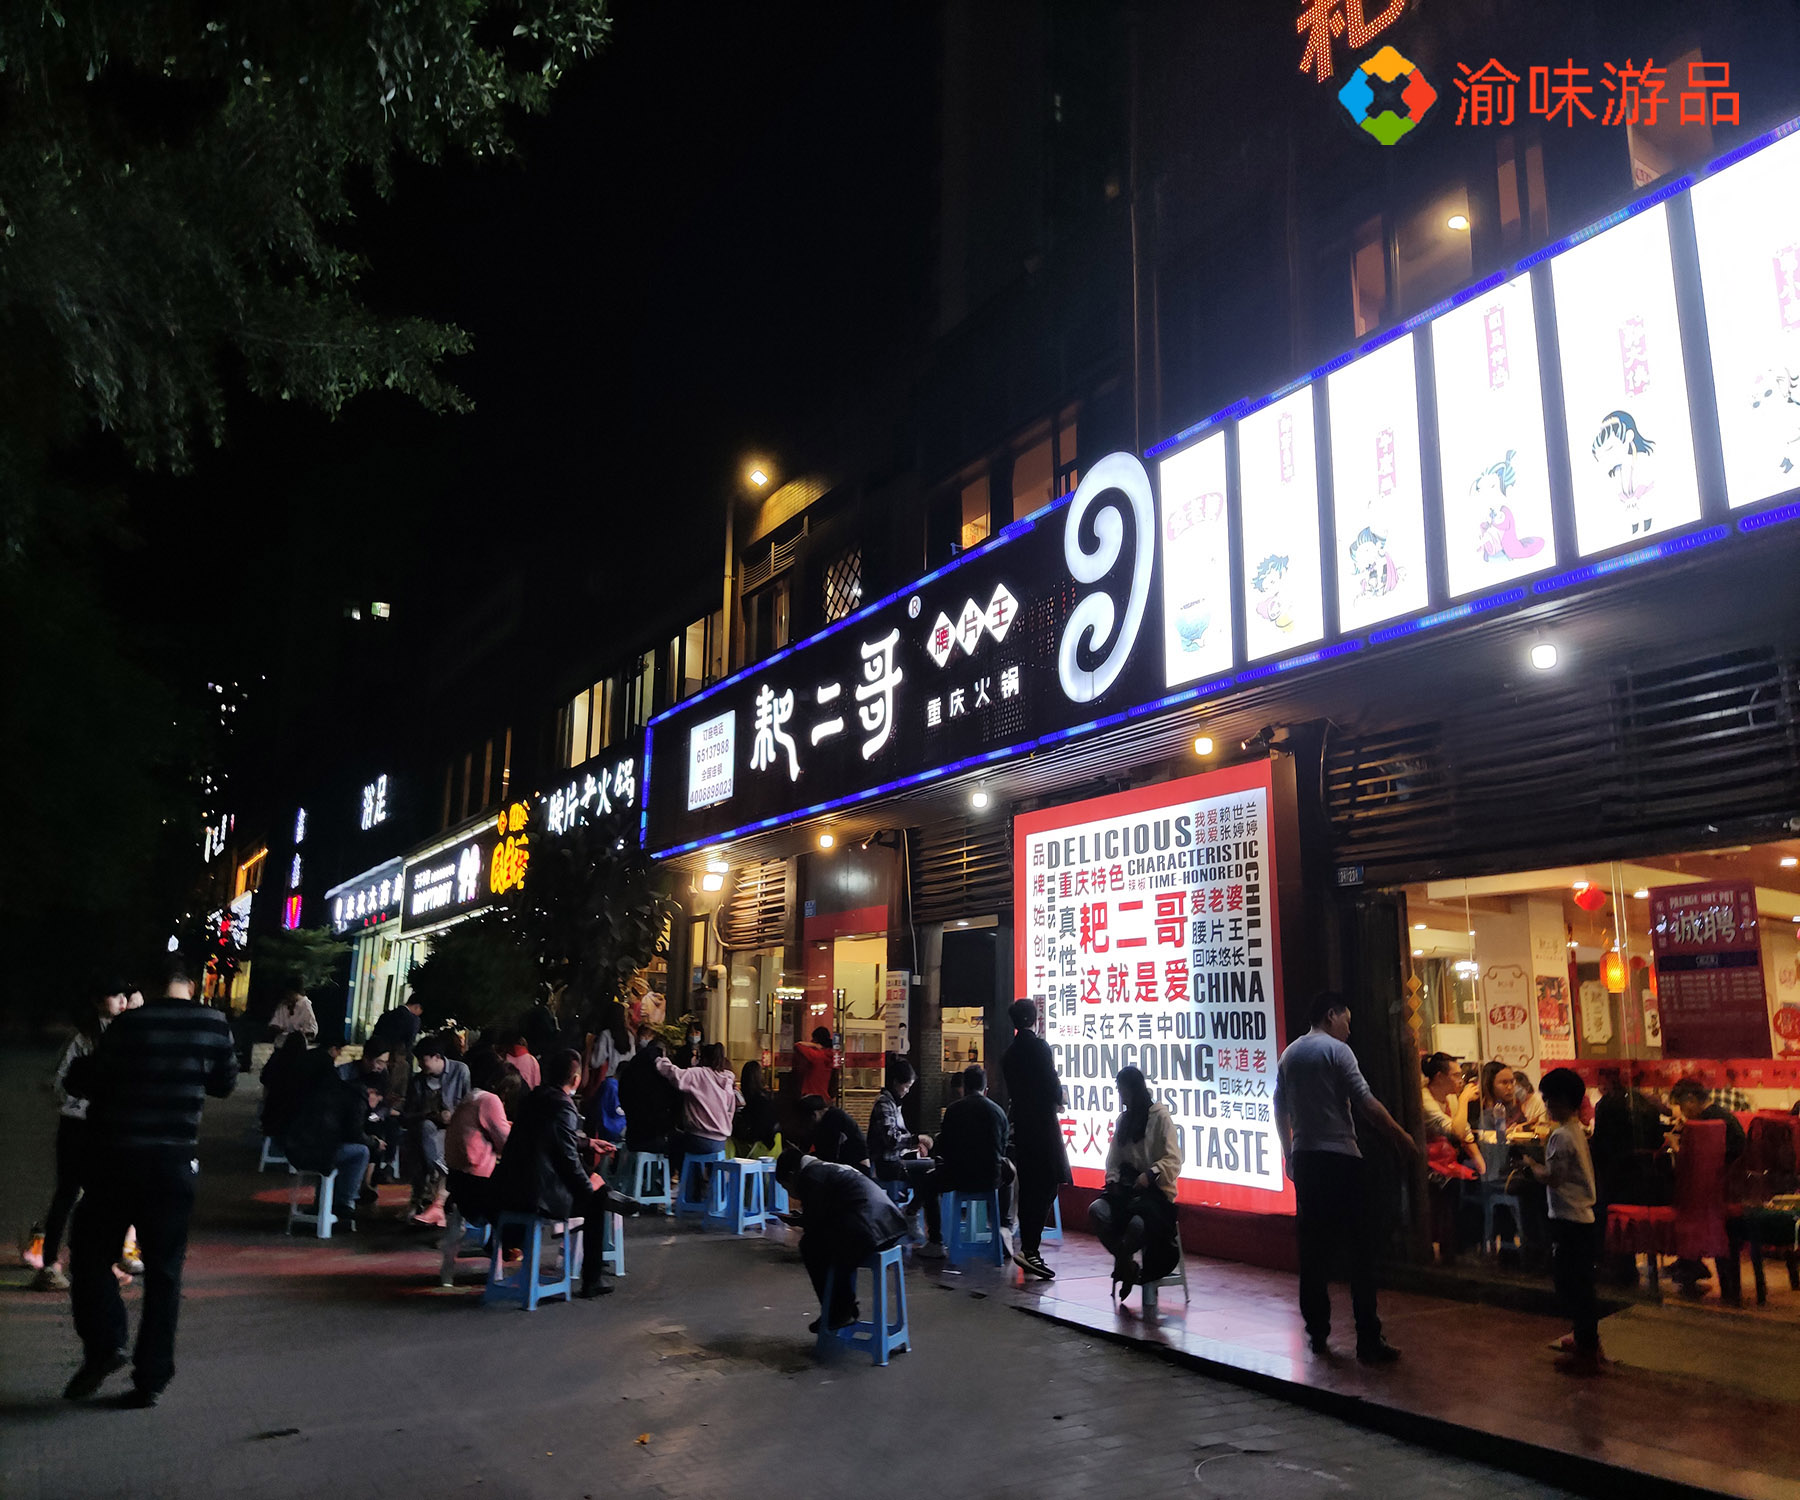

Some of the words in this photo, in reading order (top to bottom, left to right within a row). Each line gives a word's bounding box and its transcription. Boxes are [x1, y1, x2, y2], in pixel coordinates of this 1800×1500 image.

[931, 590, 1013, 660] 腰片王
[750, 628, 903, 783] 耙二哥
[927, 665, 1020, 728] 重庆火锅
[696, 739, 730, 764] 65137988
[1194, 801, 1258, 828] 我爱赖世兰
[1194, 819, 1258, 846] 我爱张婷婷
[1047, 815, 1192, 870] DELICIOUS
[1127, 839, 1259, 876] CHARACTERISTIC
[1058, 863, 1125, 899] 重庆特色
[1148, 862, 1244, 890] TIME-HONORED
[1033, 842, 1046, 988] 品牌始创于
[1191, 884, 1244, 916] 爱老婆
[1245, 861, 1263, 968] CHILLI
[1079, 890, 1188, 954] 耙二哥
[1192, 917, 1244, 944] 腰片王
[1671, 906, 1737, 945] 诚聘
[1058, 906, 1078, 1017] 真性情
[1193, 946, 1246, 968] 回味悠长
[1080, 957, 1190, 1004] 这就是爱
[1193, 970, 1265, 1004] CHINA
[1082, 1011, 1173, 1040] 尽在不言中
[1175, 1012, 1206, 1040] OLD
[1211, 1011, 1267, 1041] WORD
[1050, 1043, 1215, 1085] CHONGQING
[1218, 1047, 1267, 1074] 味道老
[1219, 1077, 1269, 1098] 回味久久
[1220, 1100, 1270, 1122] 荡气回肠
[1192, 1124, 1270, 1176] TASTE
